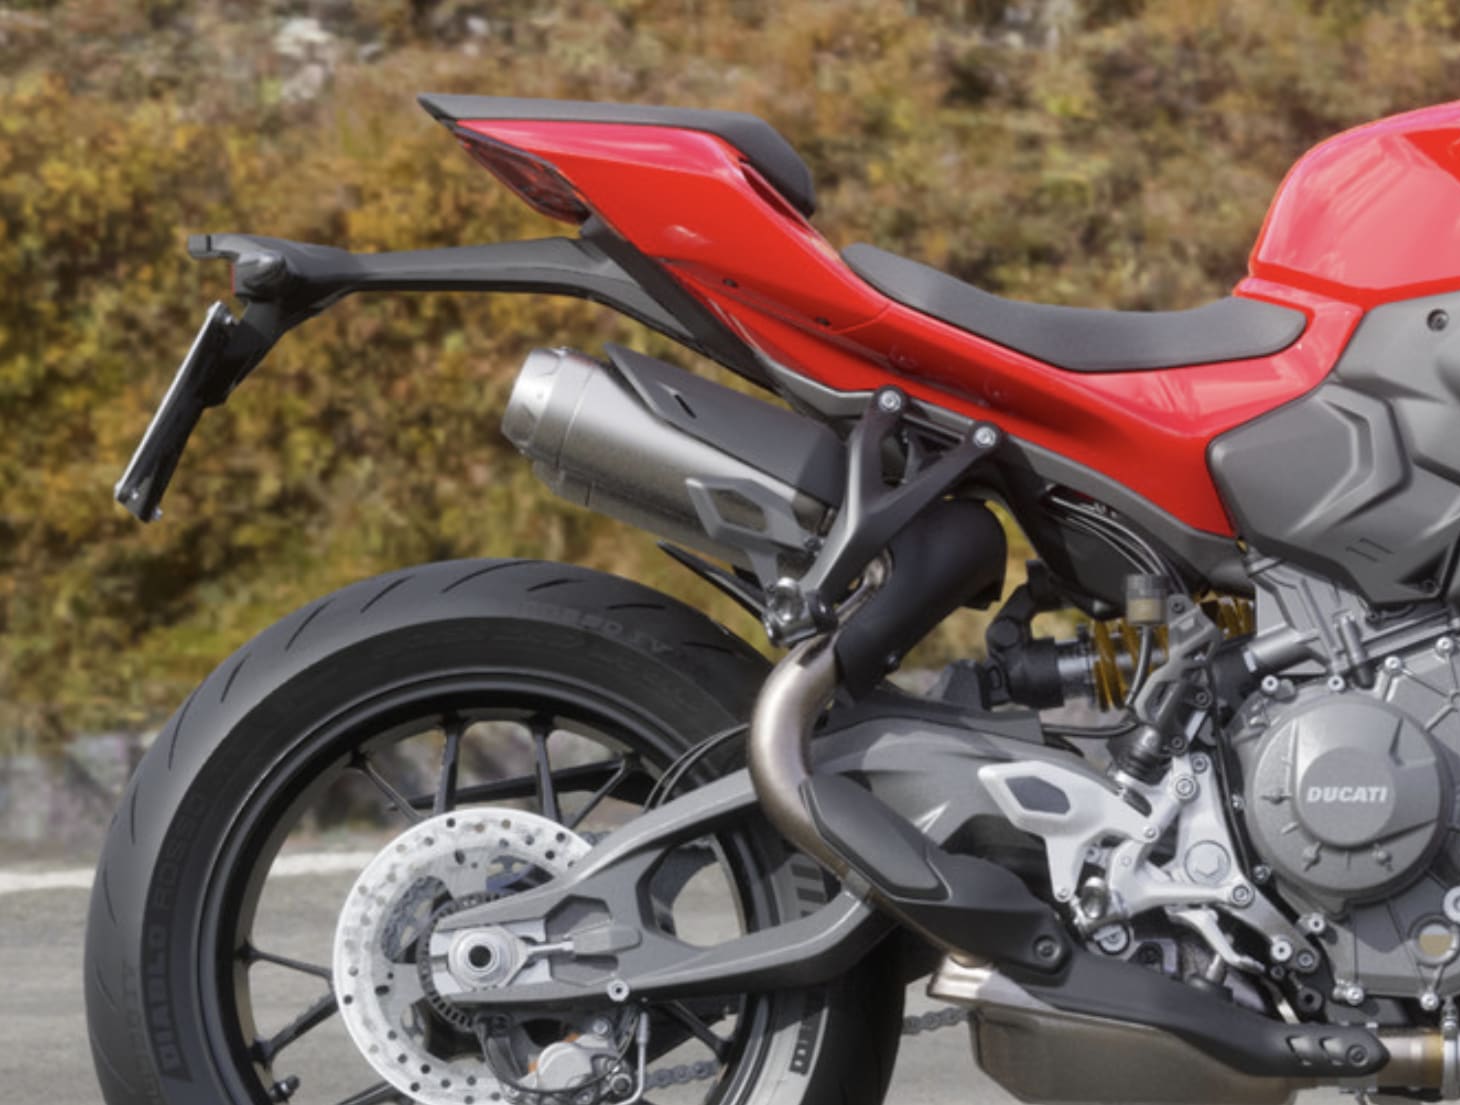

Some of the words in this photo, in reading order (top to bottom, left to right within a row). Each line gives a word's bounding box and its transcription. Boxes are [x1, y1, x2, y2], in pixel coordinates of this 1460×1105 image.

[159, 793, 208, 910] ROSSO
[1307, 786, 1387, 804] DUCATI
[147, 924, 180, 1069] DIABLO
